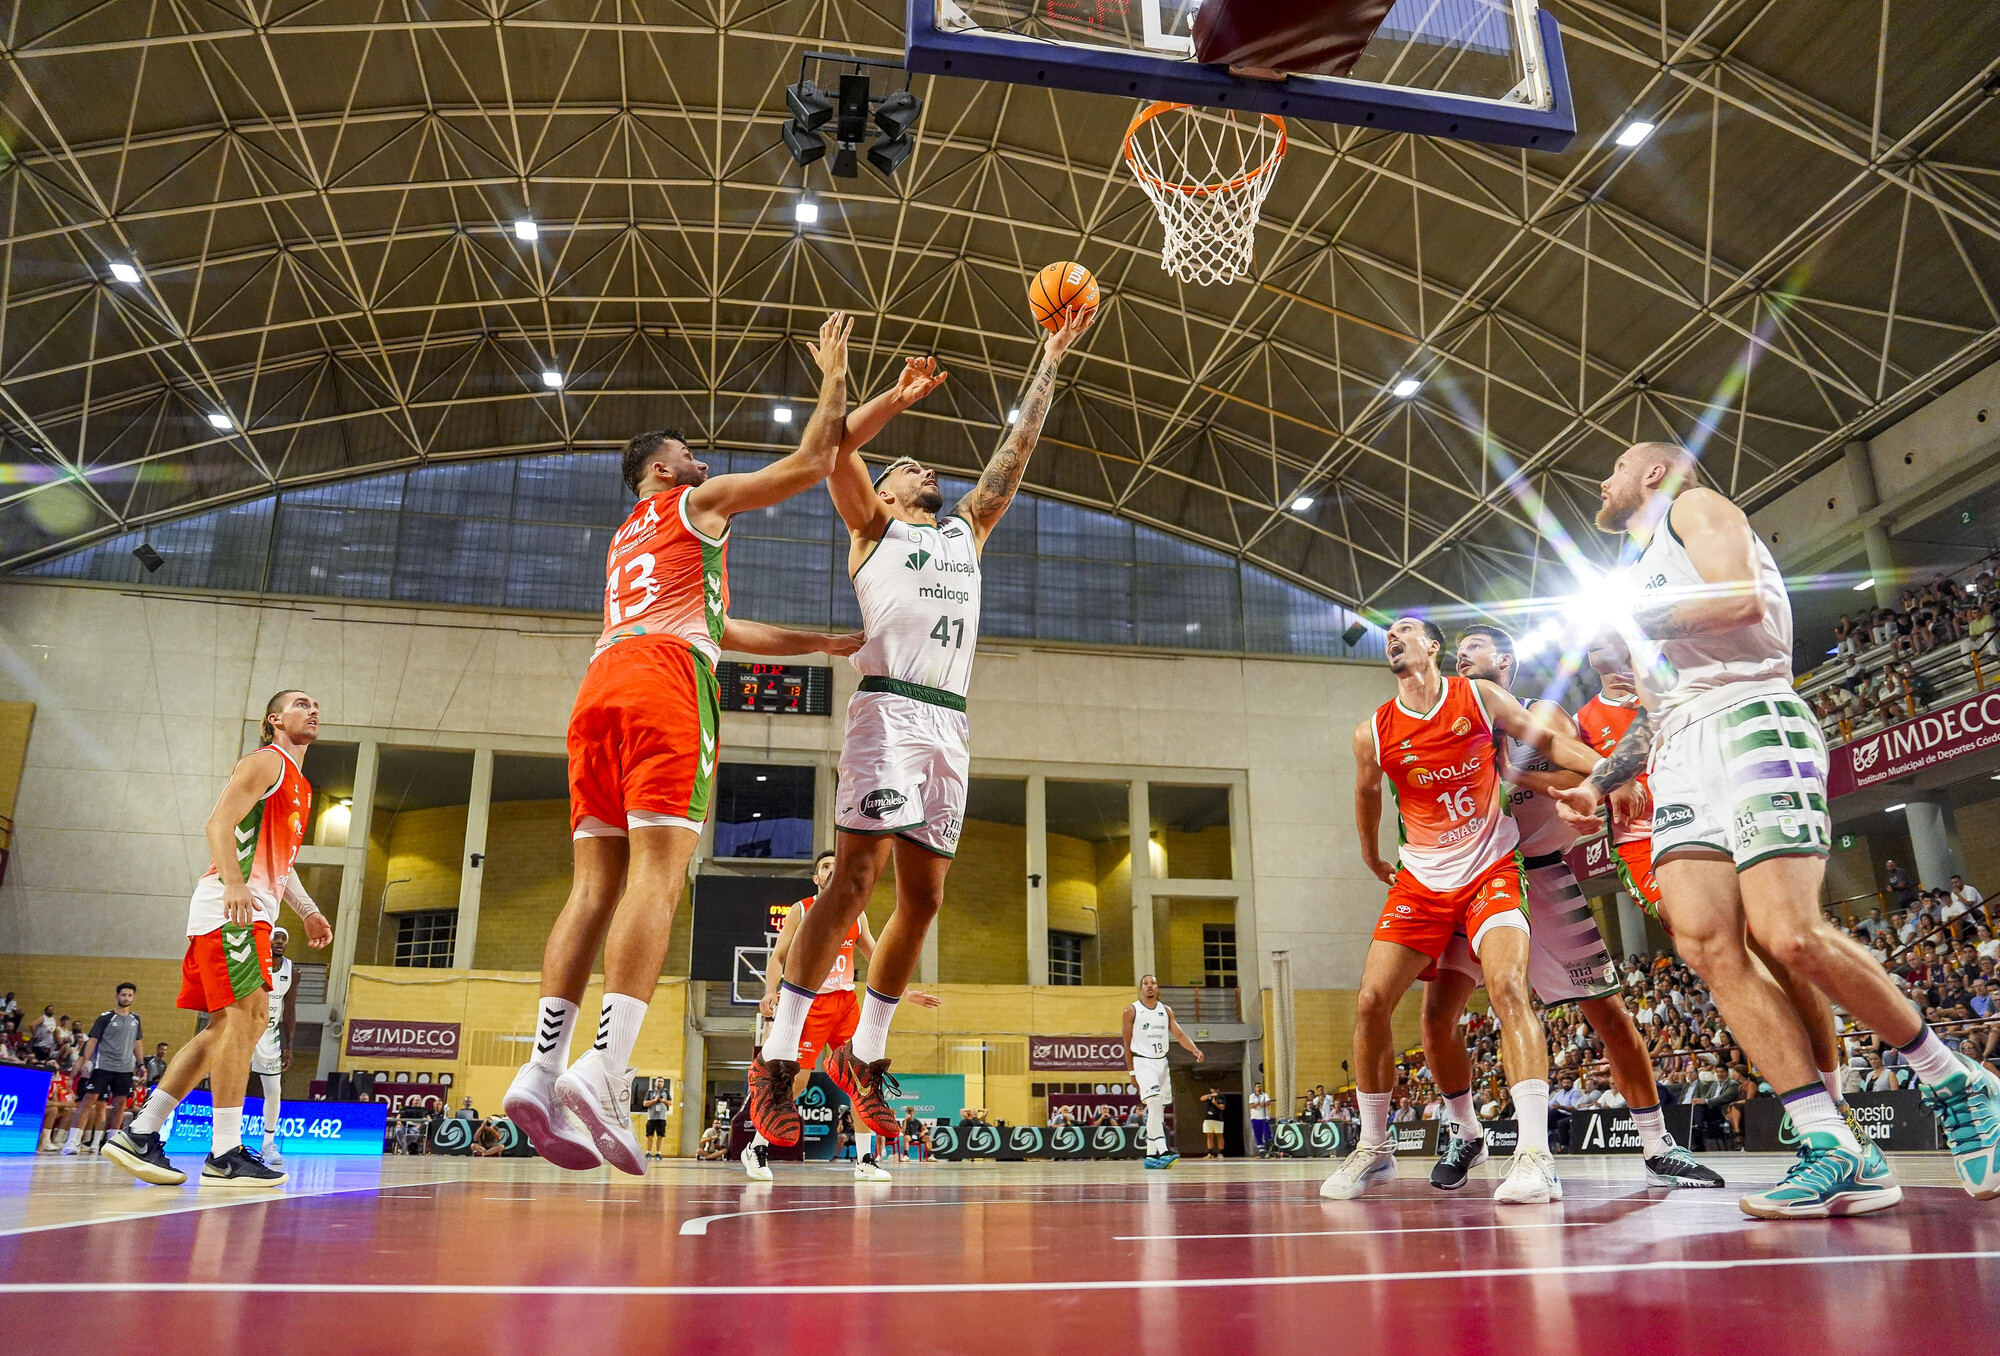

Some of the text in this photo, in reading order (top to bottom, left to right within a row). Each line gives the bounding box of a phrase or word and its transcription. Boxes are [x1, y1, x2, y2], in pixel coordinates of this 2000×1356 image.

[1961, 512, 1971, 524] 2
[606, 552, 660, 627] 13
[919, 582, 970, 605] málaga
[929, 615, 965, 650] 41
[743, 683, 759, 695] 27
[767, 680, 775, 690] 2
[790, 686, 802, 697] 13
[747, 696, 799, 708] 0 2
[1883, 693, 2000, 761] IMDECO
[1417, 756, 1481, 785] INSOLAC
[1857, 771, 1888, 787] Instituto
[1887, 757, 1925, 777] Municipal
[1925, 753, 1937, 765] de
[1937, 741, 1977, 761] Deportes
[862, 791, 906, 814] famadesa
[1436, 785, 1477, 822] 16
[1653, 808, 1693, 830] adesa
[1841, 834, 1852, 849] B
[376, 1027, 457, 1047] IMDECO
[1054, 1044, 1125, 1059] IMDECO
[1151, 1042, 1164, 1055] 19
[308, 1118, 342, 1139] 482
[1609, 1117, 1638, 1133] Junta
[1608, 1134, 1622, 1148] de
